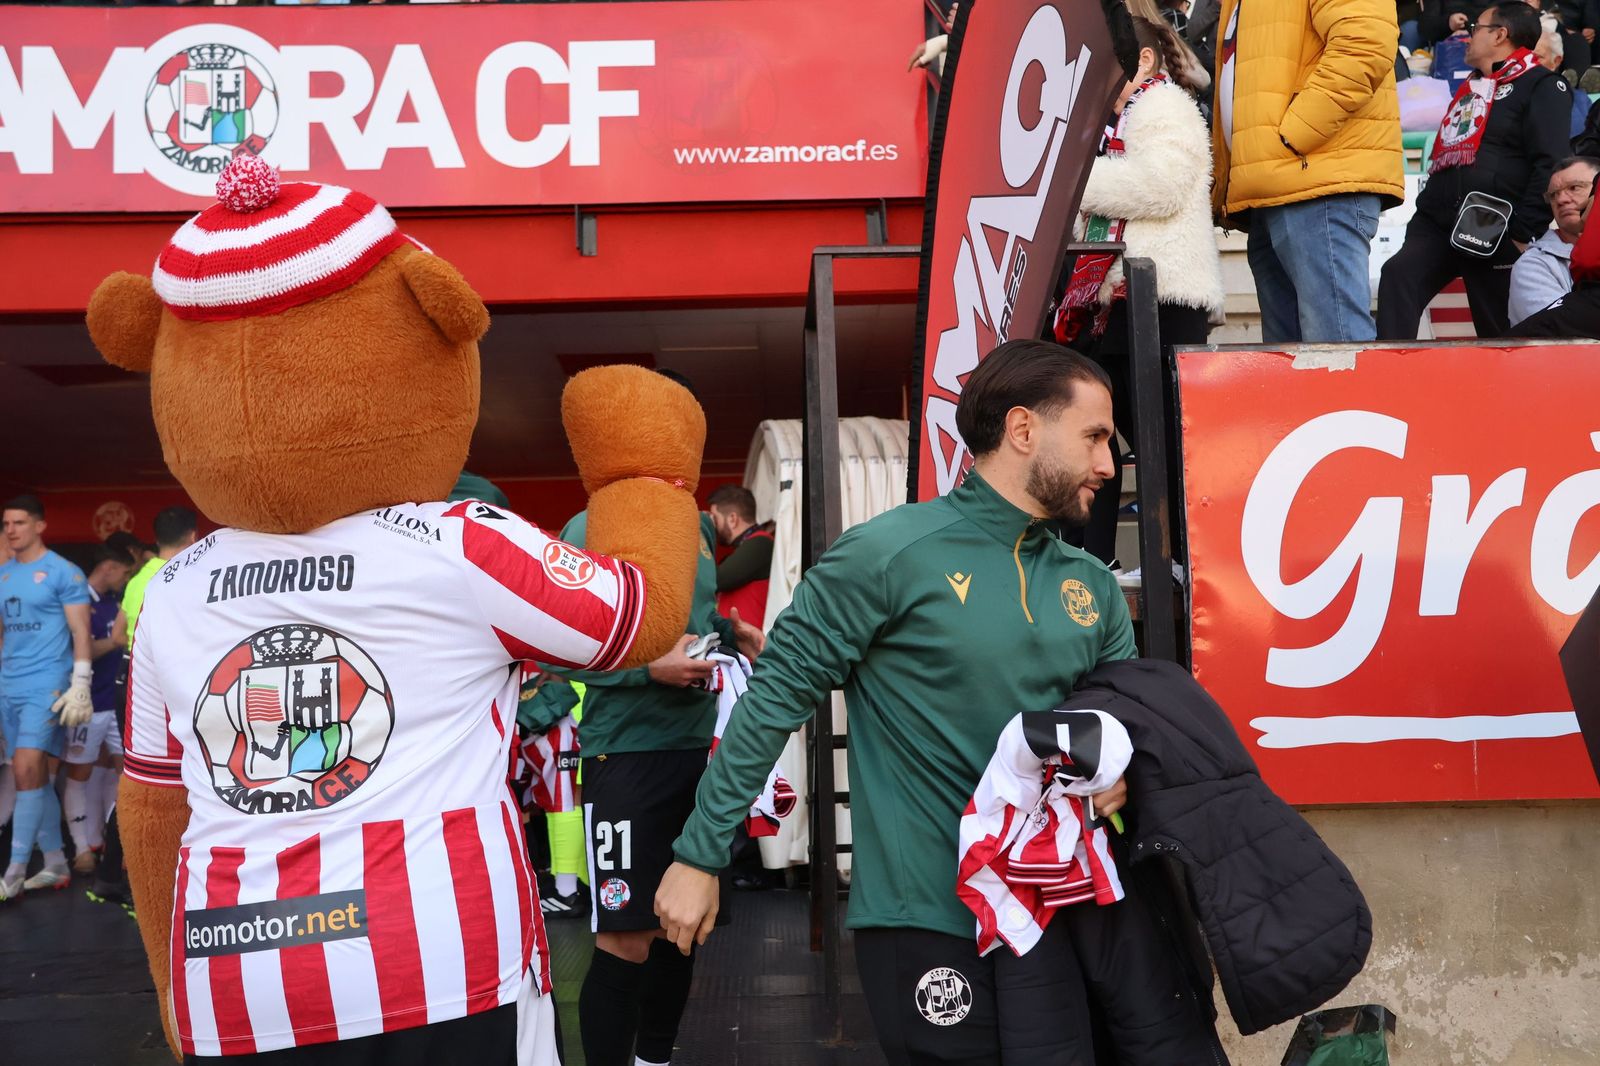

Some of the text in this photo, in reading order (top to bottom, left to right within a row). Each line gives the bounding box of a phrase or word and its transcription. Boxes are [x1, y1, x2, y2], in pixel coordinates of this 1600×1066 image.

[475, 40, 656, 168] CF
[673, 139, 898, 165] www.zamoracf.es
[1458, 232, 1483, 246] adidas
[373, 519, 390, 530] RUIZ
[390, 526, 418, 541] LOPERA,
[206, 554, 355, 604] ZAMOROSO
[72, 727, 89, 744] 14
[595, 819, 632, 870] 21
[186, 902, 361, 949] leomotor.net
